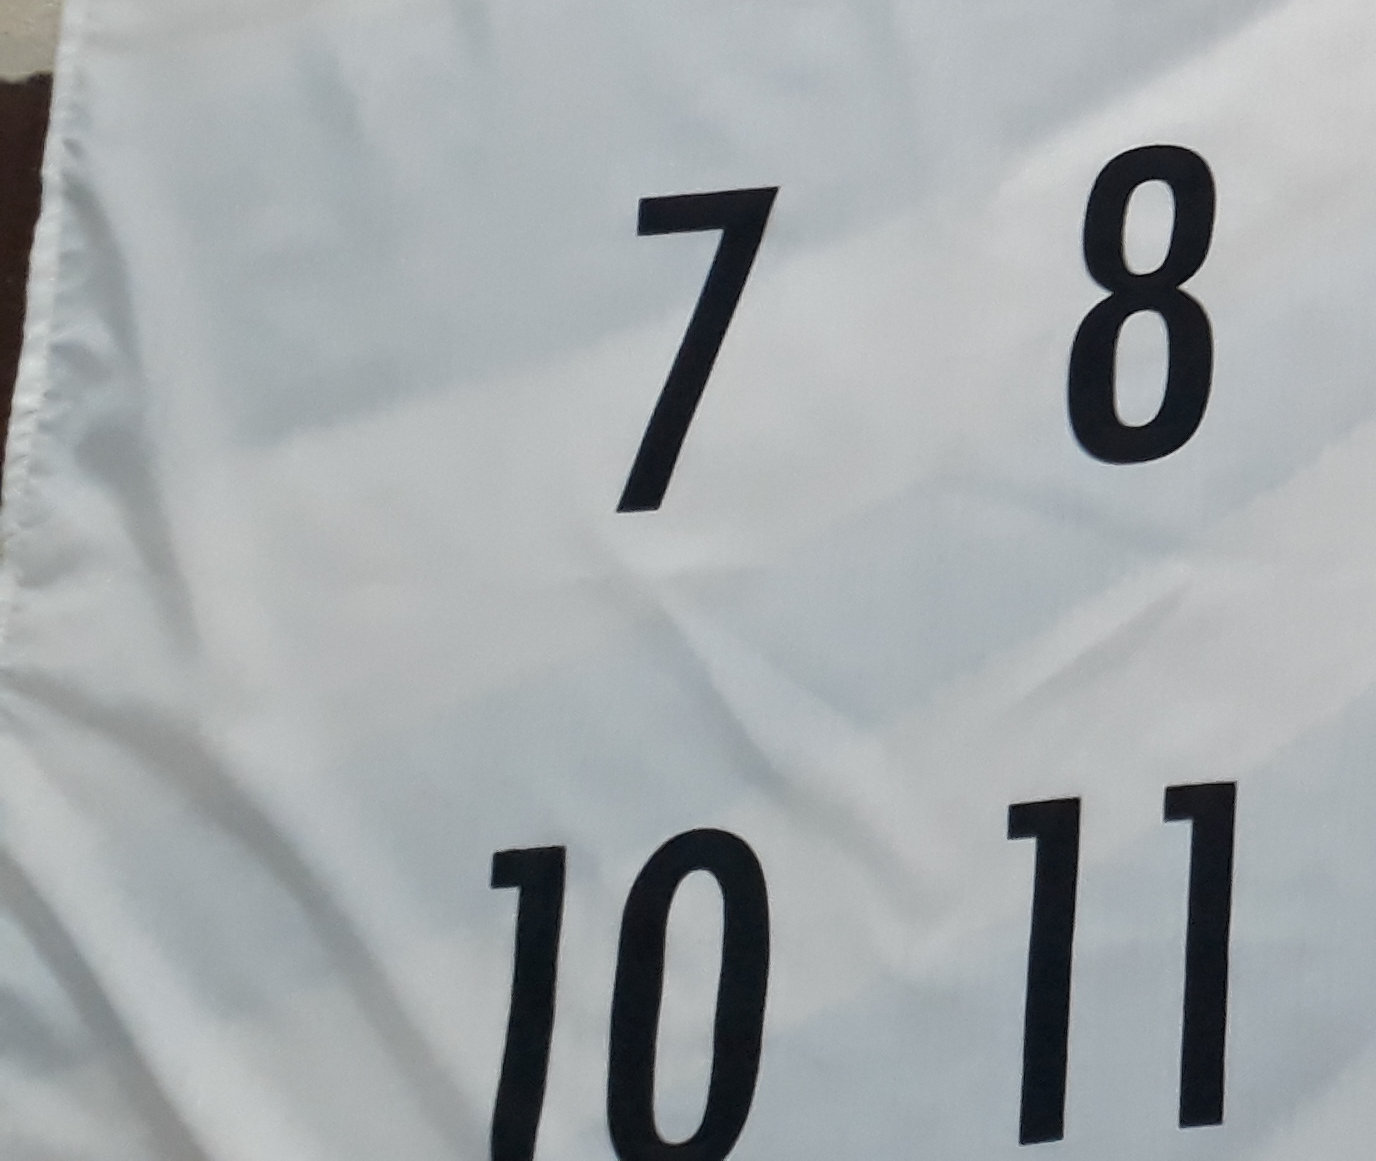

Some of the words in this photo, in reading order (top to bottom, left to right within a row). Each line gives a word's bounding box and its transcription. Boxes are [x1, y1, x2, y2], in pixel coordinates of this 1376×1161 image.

[617, 187, 778, 513] 7
[1068, 145, 1215, 464] 8
[491, 829, 770, 1161] 10
[1008, 782, 1237, 1146] 11
